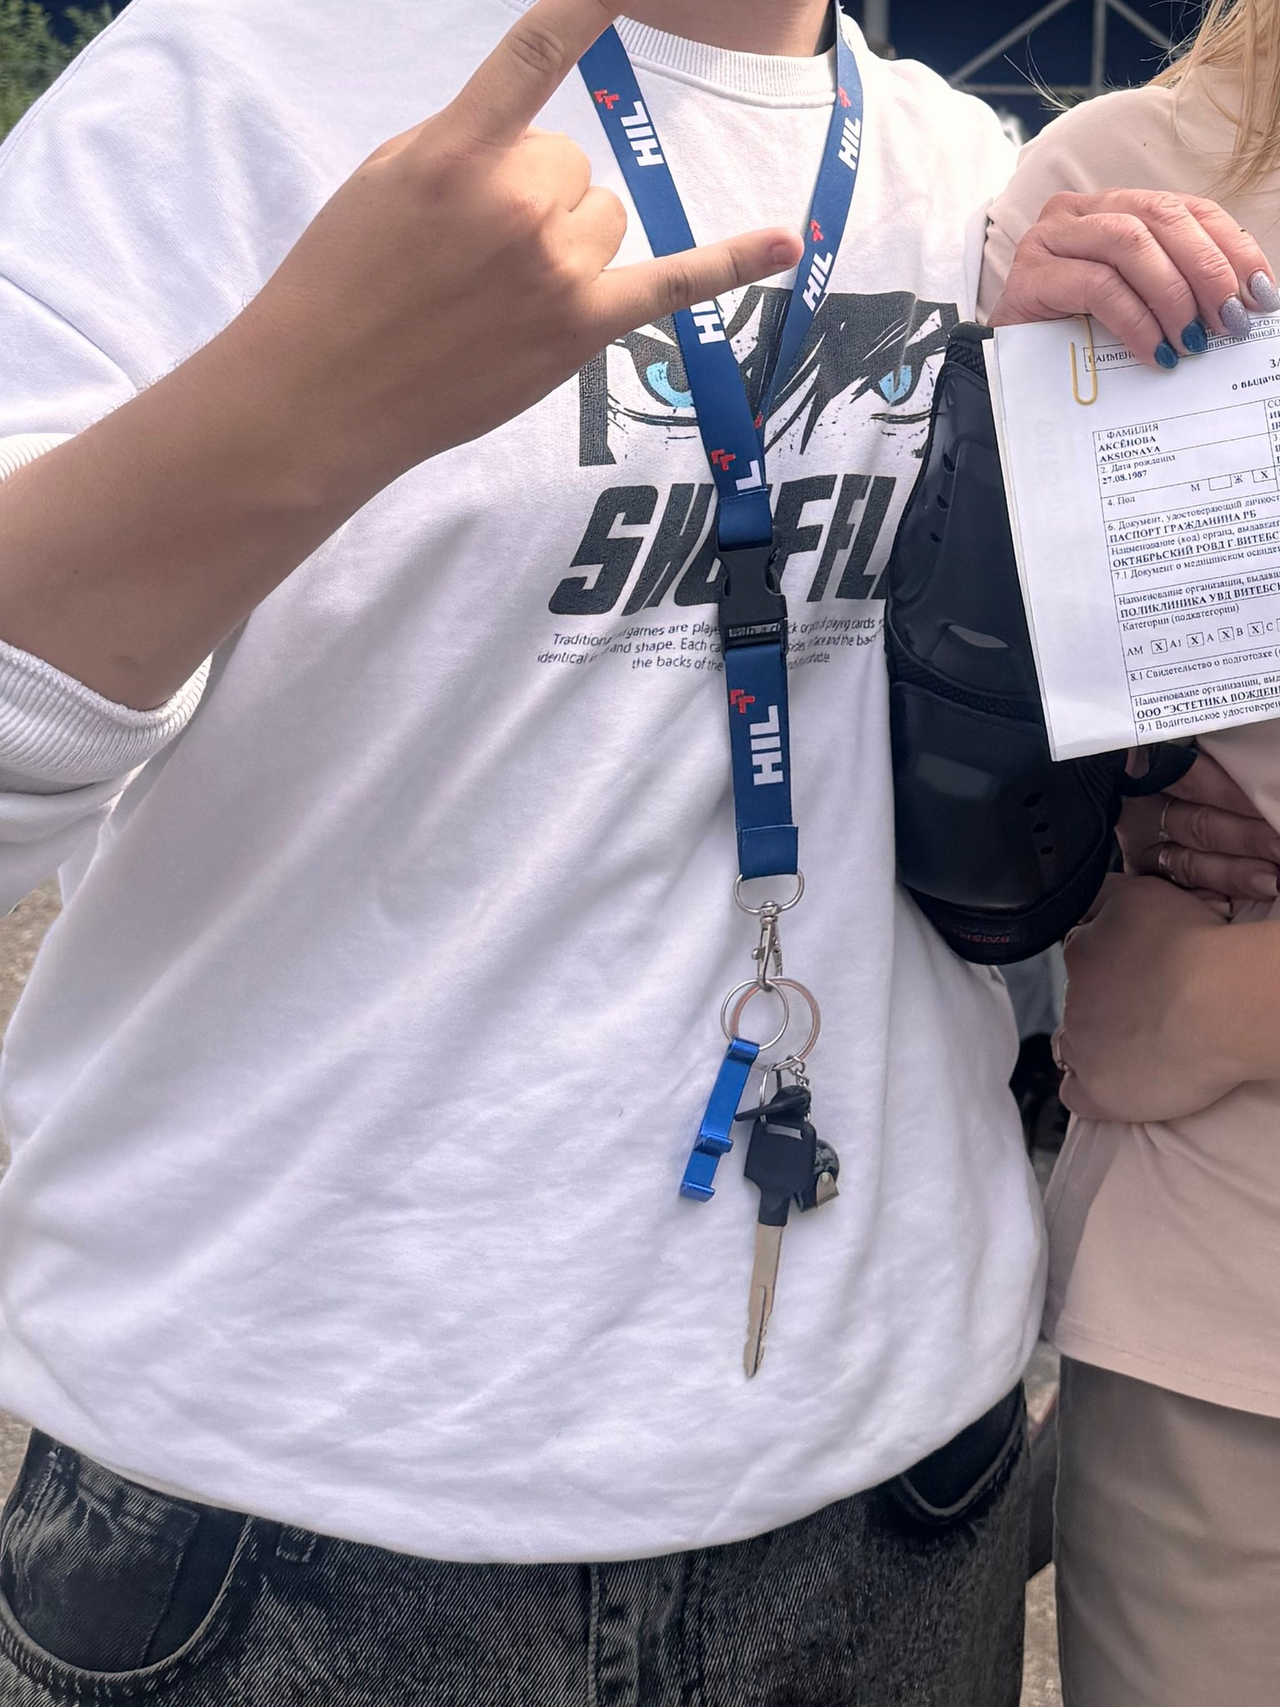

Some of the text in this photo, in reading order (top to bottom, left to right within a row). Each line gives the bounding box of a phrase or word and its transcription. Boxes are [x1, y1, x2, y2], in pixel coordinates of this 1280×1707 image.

[619, 101, 664, 167] HIL
[837, 117, 861, 170] HIL
[802, 252, 833, 312] HIL
[690, 300, 726, 344] HI
[1241, 373, 1280, 389] выдаче
[1106, 422, 1159, 440] ФАМИЛИЯ
[1098, 435, 1156, 453] АКСЁНОВА
[1100, 445, 1161, 463] AKSIONAVA
[1111, 453, 1176, 473] Дата рождения
[1233, 475, 1244, 485] Ж
[1117, 495, 1136, 506] Пол
[1109, 510, 1257, 543] ПАСПОРТ ГРАЖДАНИНА РБ
[1118, 517, 1163, 532] Документ,
[1166, 501, 1242, 523] удостоверяющий
[1111, 538, 1175, 556] Наименование
[1177, 532, 1200, 546] (код)
[1113, 545, 1194, 568] ОКТЯБРЬСКИЙ
[1196, 540, 1225, 554] РОВД
[1114, 572, 1128, 581] 7.1
[1130, 564, 1174, 580] Документ
[1183, 551, 1245, 569] медицинском
[1118, 588, 1183, 606] Наименование
[1120, 597, 1207, 618] ПОЛИКЛИНИКА
[1209, 591, 1232, 603] УВД
[668, 623, 688, 635] are
[1122, 603, 1240, 633] Категории (подкатегории)
[634, 640, 676, 656] shape.
[681, 637, 707, 651] Each
[1127, 646, 1144, 657] AM
[632, 658, 653, 670] the
[656, 655, 691, 669] backs
[694, 658, 706, 670] of
[1145, 660, 1212, 680] Свидетельство
[1222, 650, 1272, 666] подготовке
[1135, 688, 1199, 706] Наименование
[1136, 707, 1161, 720] ООО
[1163, 696, 1228, 714] "ЭСТЕТИКА
[1138, 722, 1153, 733] 9.1
[1156, 710, 1220, 730] Водительское
[750, 705, 784, 786] HIL
